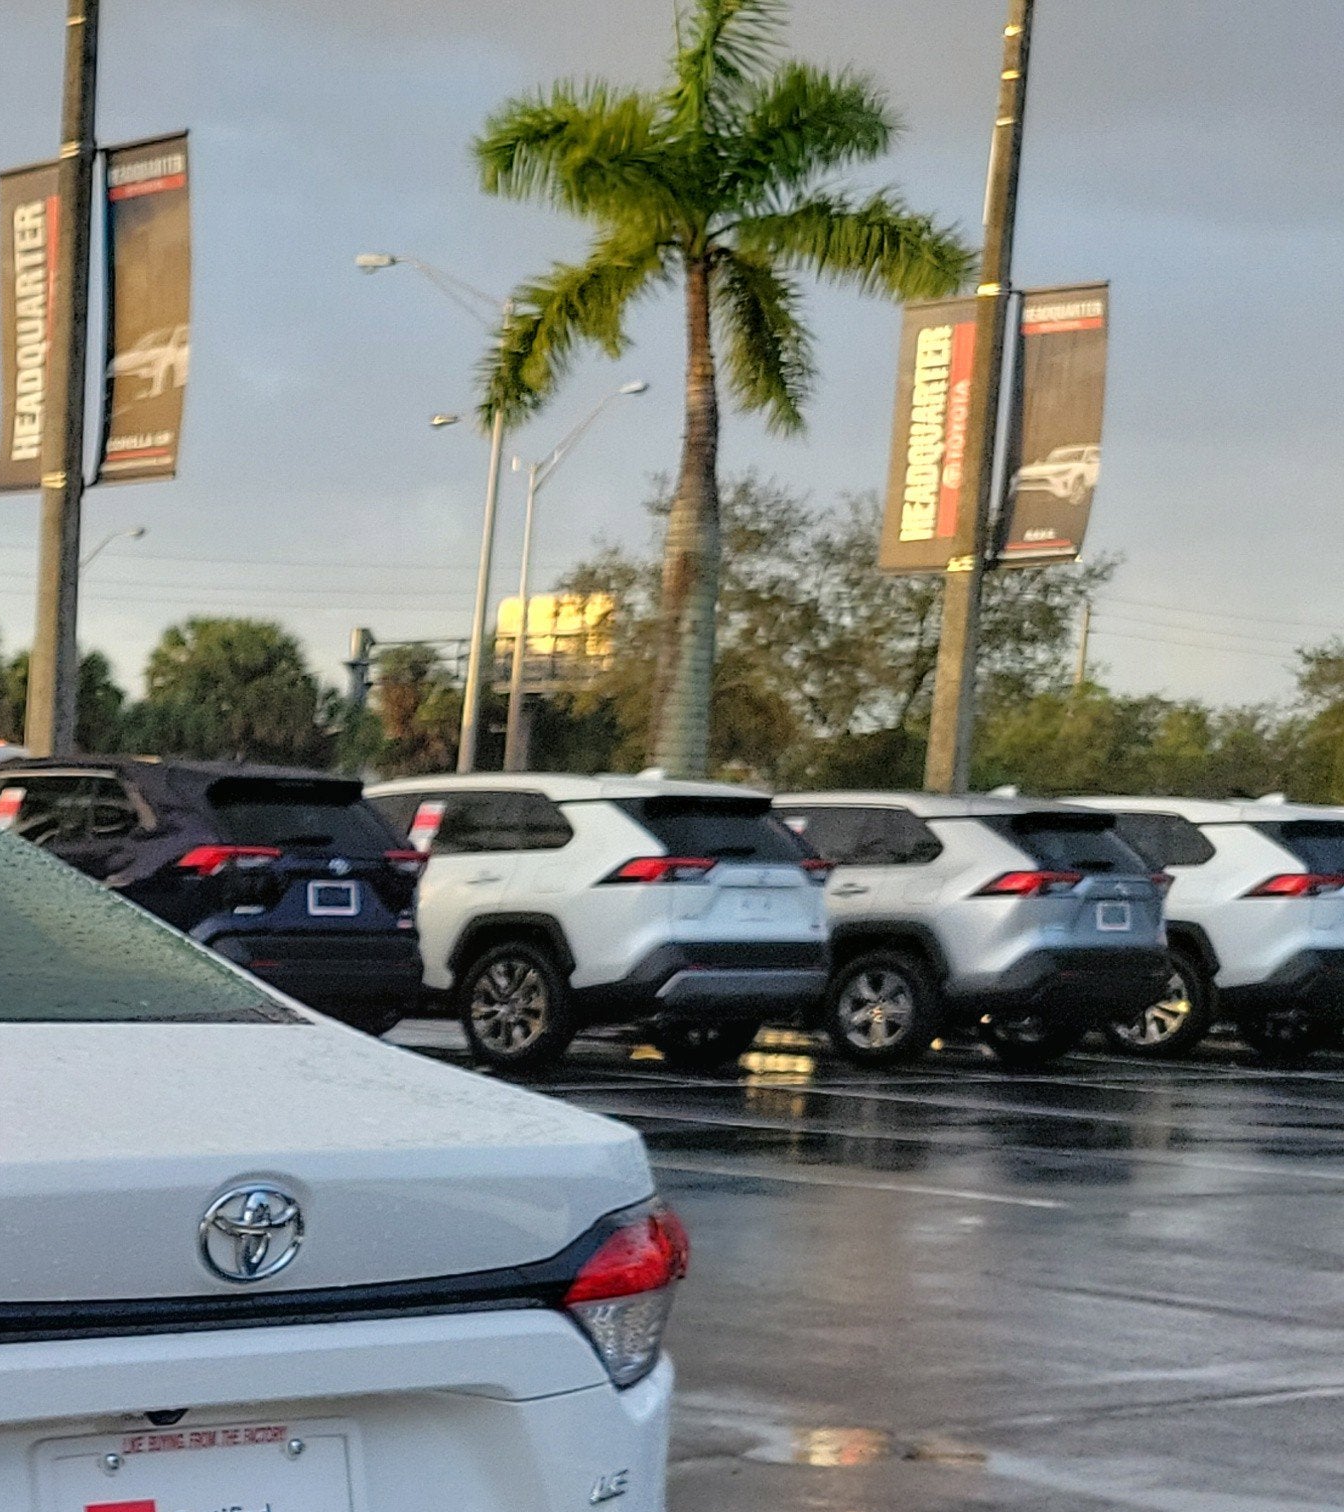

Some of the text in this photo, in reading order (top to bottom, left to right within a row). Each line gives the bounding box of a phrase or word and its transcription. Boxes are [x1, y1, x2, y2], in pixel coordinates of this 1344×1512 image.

[11, 200, 48, 461] HEADQUARTER
[899, 324, 953, 541] HEADQUARTER
[590, 1468, 629, 1505] LE
